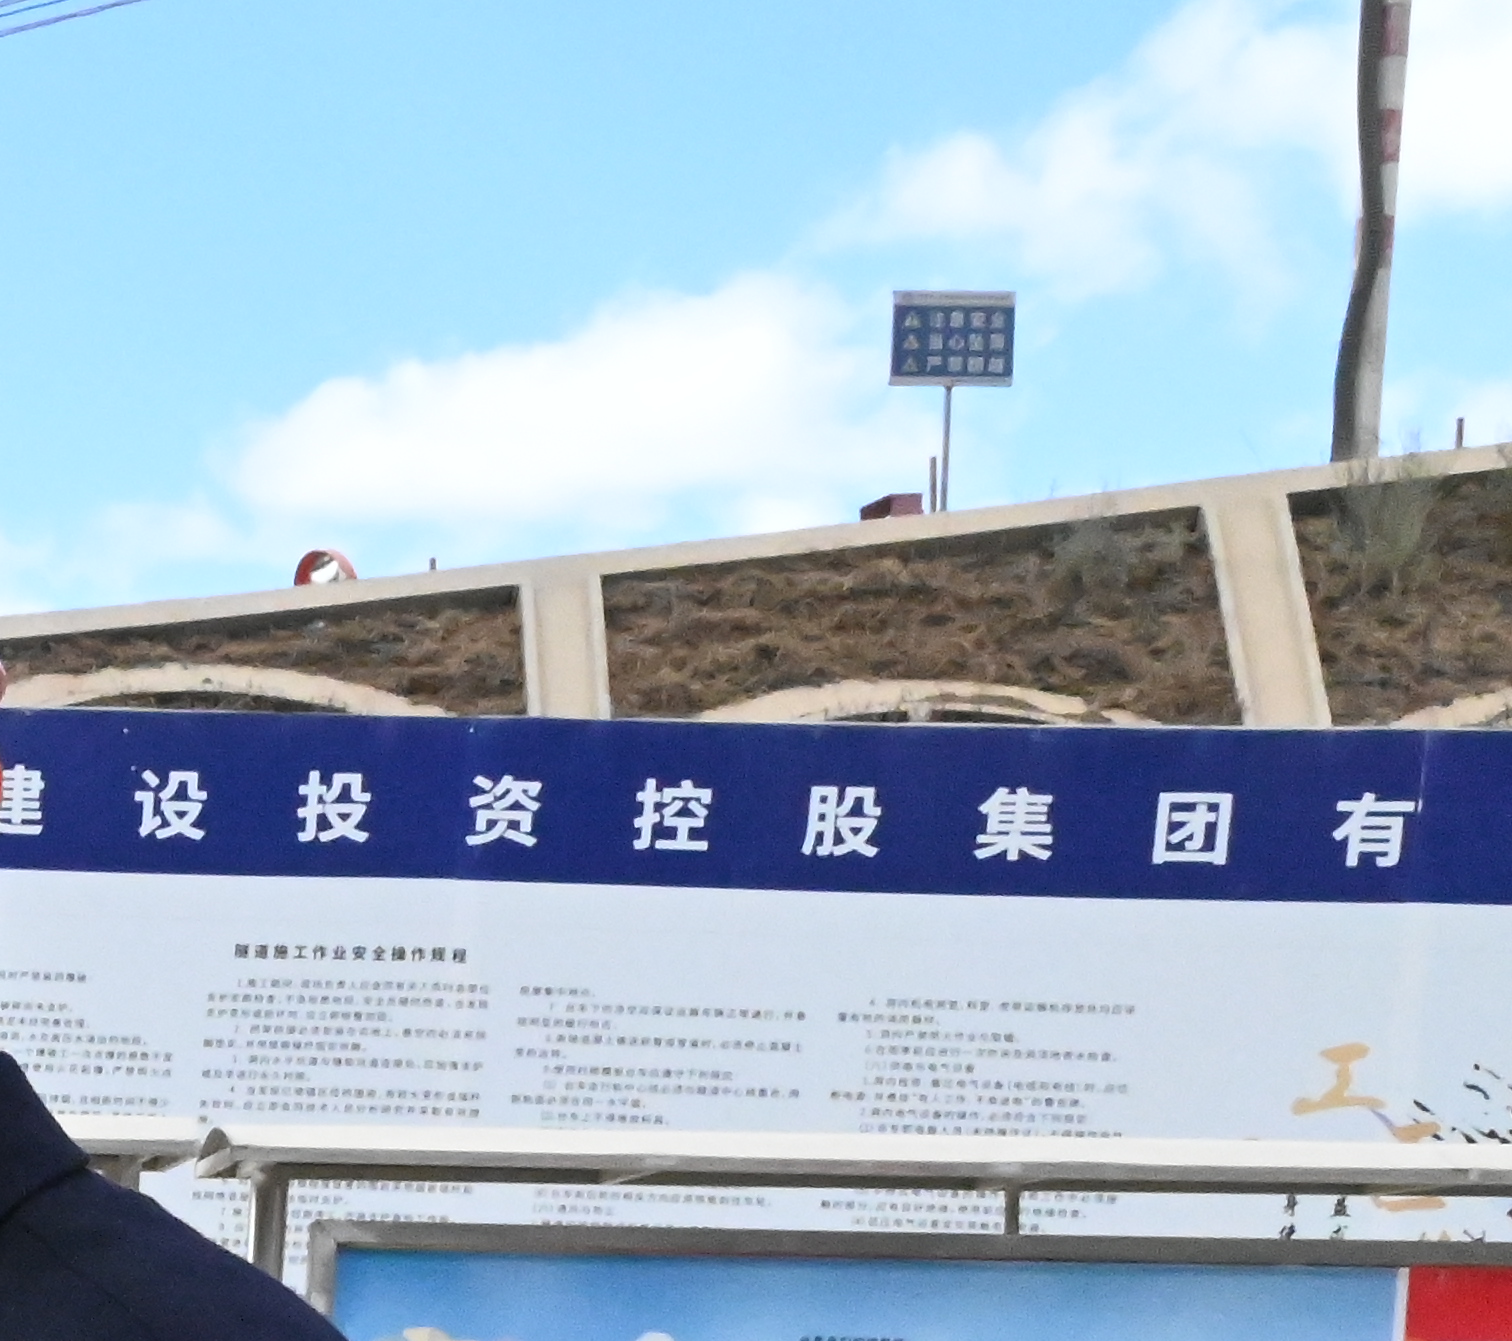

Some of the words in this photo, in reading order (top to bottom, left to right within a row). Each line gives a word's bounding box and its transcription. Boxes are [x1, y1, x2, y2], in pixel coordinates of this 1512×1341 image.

[234, 943, 468, 965] 隧道施工作业安全操作规程
